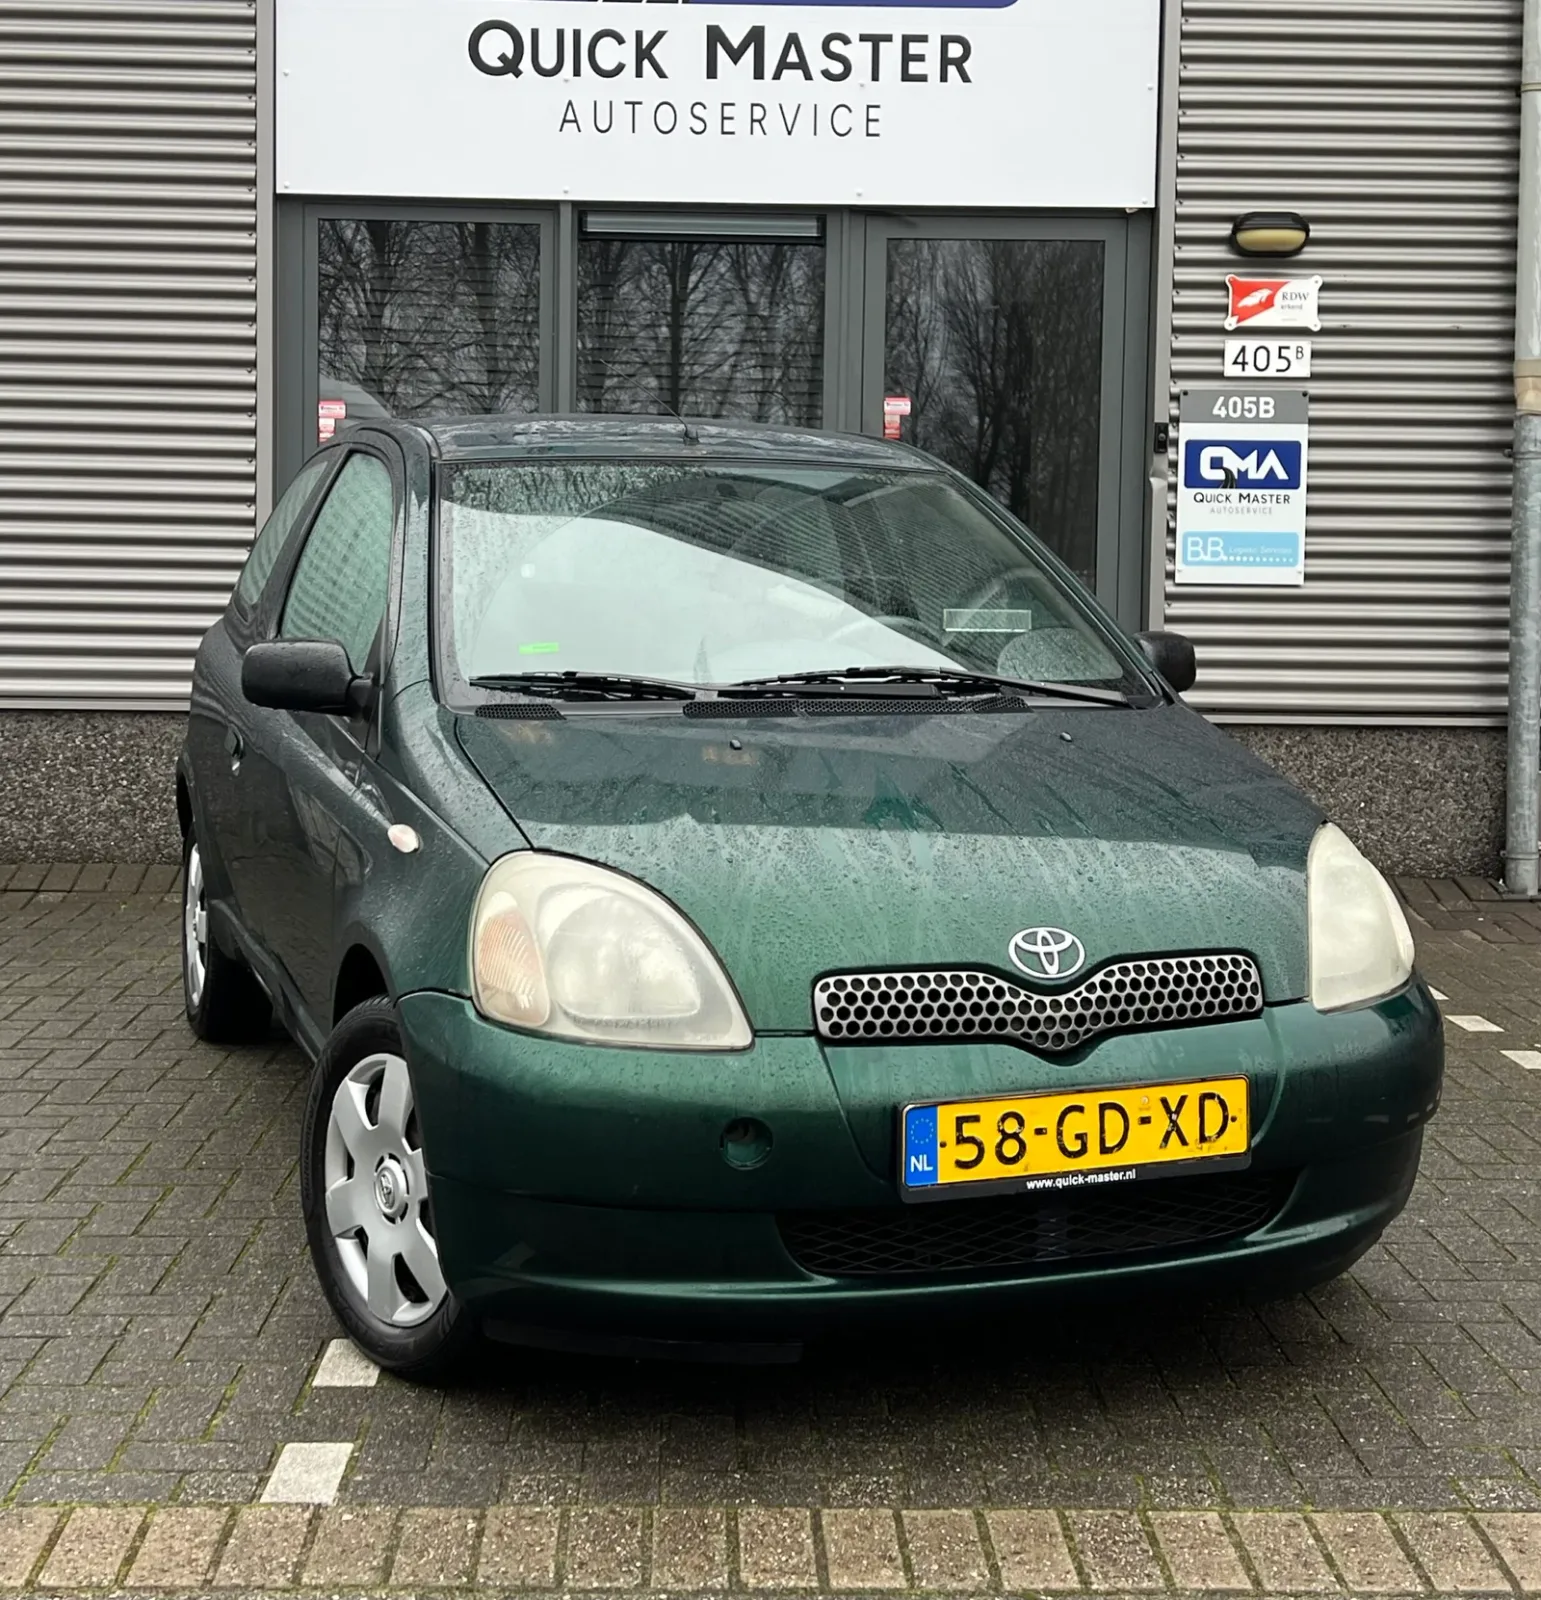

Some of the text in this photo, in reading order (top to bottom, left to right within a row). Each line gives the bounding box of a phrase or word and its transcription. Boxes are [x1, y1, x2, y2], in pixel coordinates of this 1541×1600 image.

[468, 19, 973, 83] QUICK MASTER
[559, 100, 882, 138] AUTOSERVICE
[1281, 291, 1310, 302] RDW
[1212, 396, 1275, 419] 405B
[1193, 492, 1291, 505] QUICK MASTER
[1210, 506, 1273, 515] AUTOSERVICE
[954, 1091, 1229, 1170] 58-GD-XD
[910, 1154, 933, 1173] NL
[1026, 1168, 1137, 1190] www.quick-master.nl
